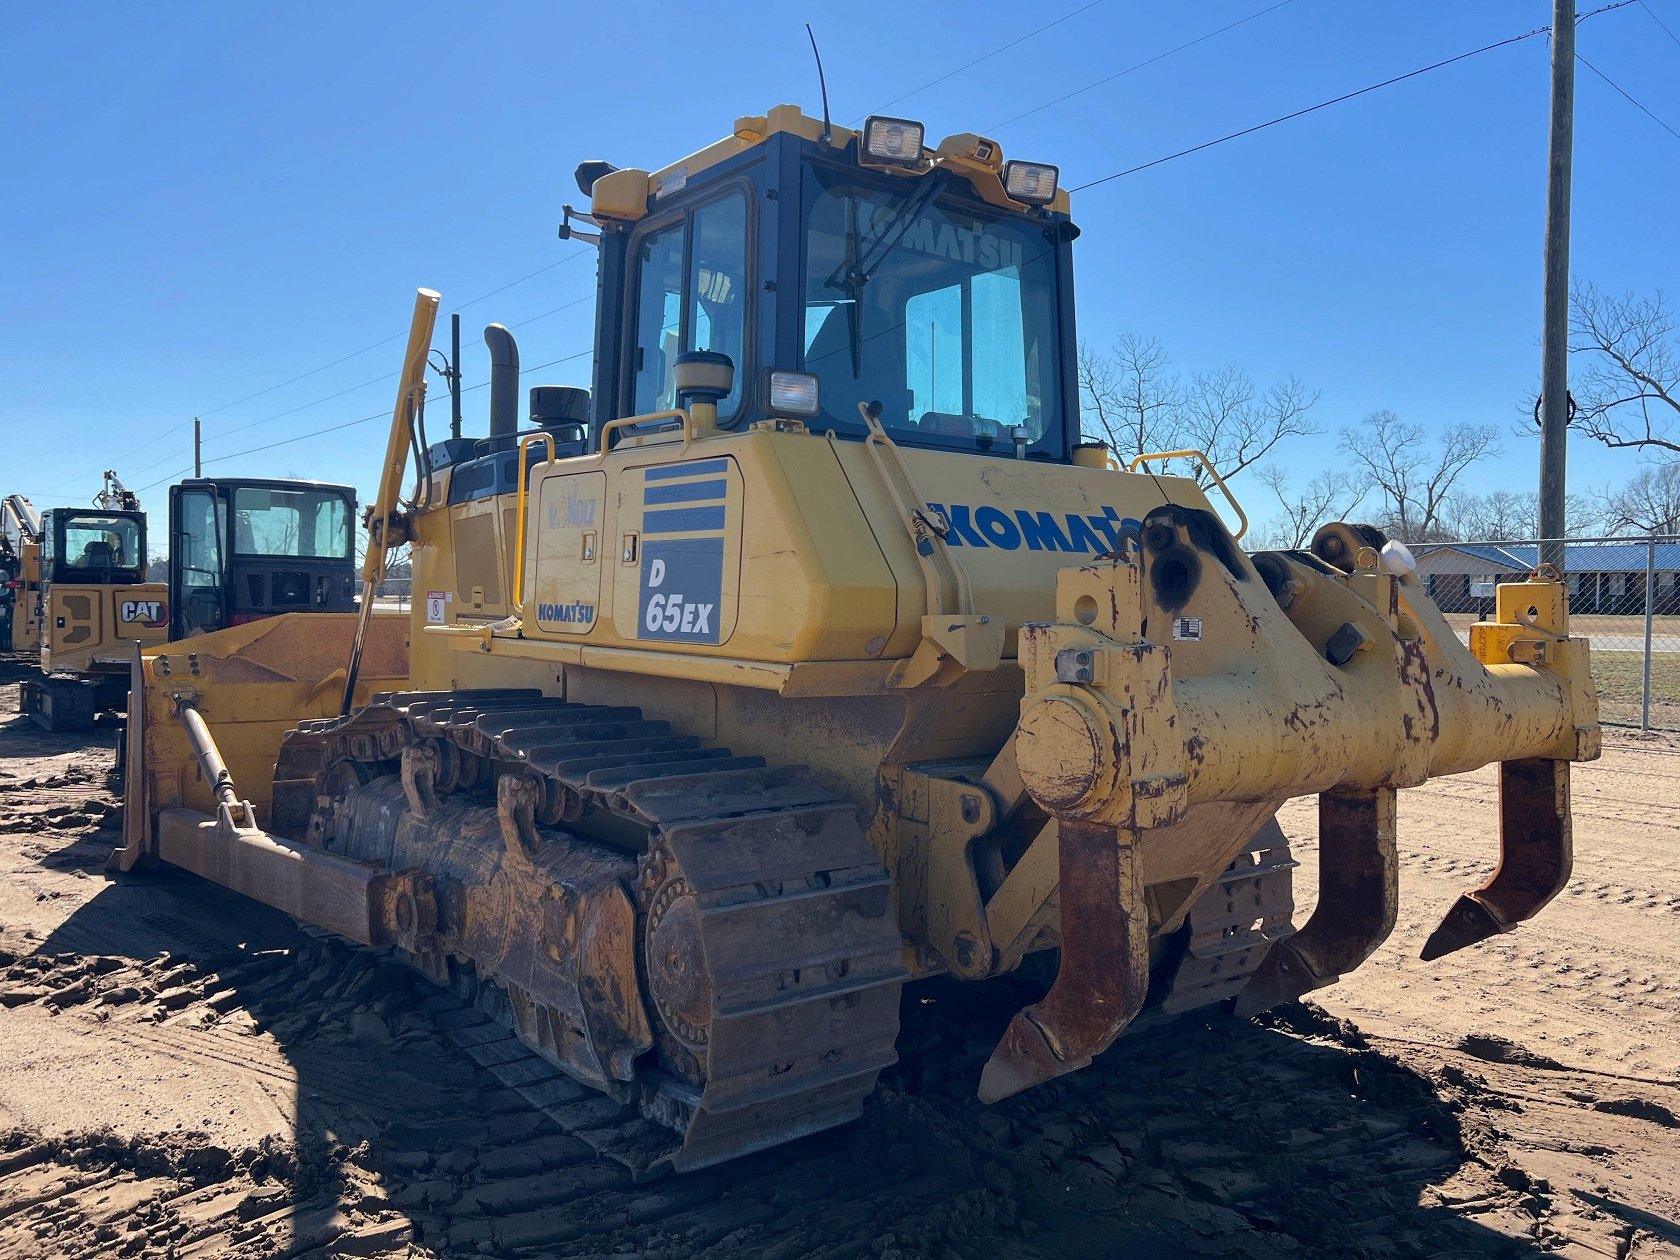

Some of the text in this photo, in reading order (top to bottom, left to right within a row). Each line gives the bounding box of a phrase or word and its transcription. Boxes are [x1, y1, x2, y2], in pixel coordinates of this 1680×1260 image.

[649, 559, 666, 588] D
[122, 601, 161, 622] CAT
[538, 600, 594, 624] KOMATSU
[646, 594, 713, 634] 65EX
